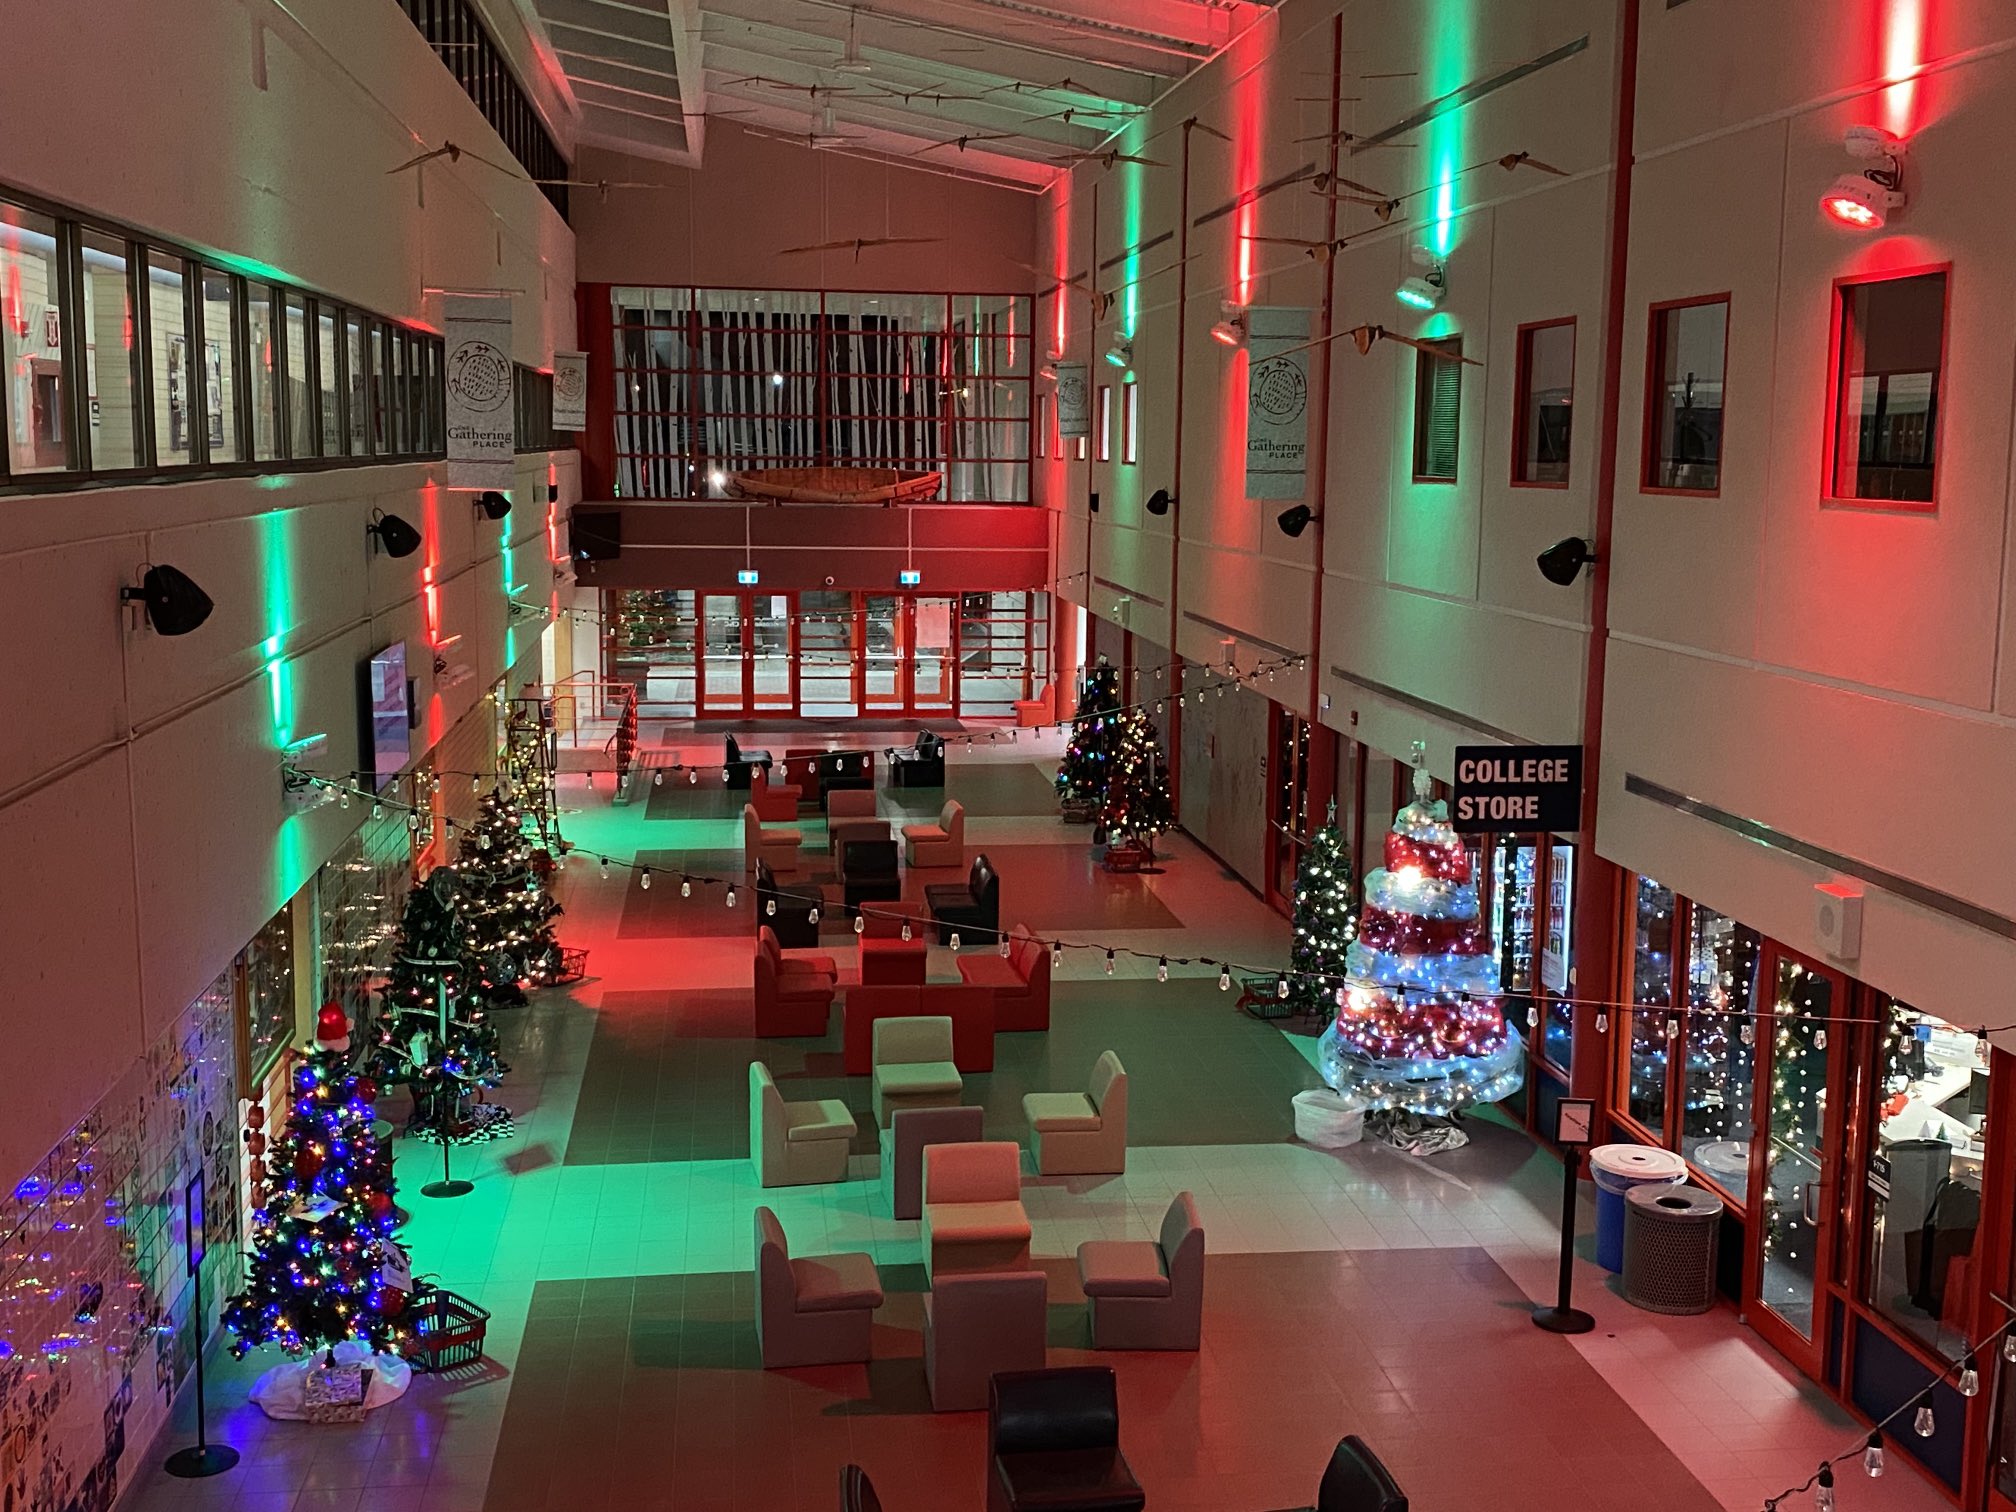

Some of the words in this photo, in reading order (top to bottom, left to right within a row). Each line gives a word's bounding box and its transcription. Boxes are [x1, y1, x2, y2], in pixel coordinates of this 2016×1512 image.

[448, 427, 512, 443] Gathering
[1248, 440, 1305, 454] Gathering
[1459, 759, 1568, 783] COLLEGE
[1458, 796, 1539, 819] STORE
